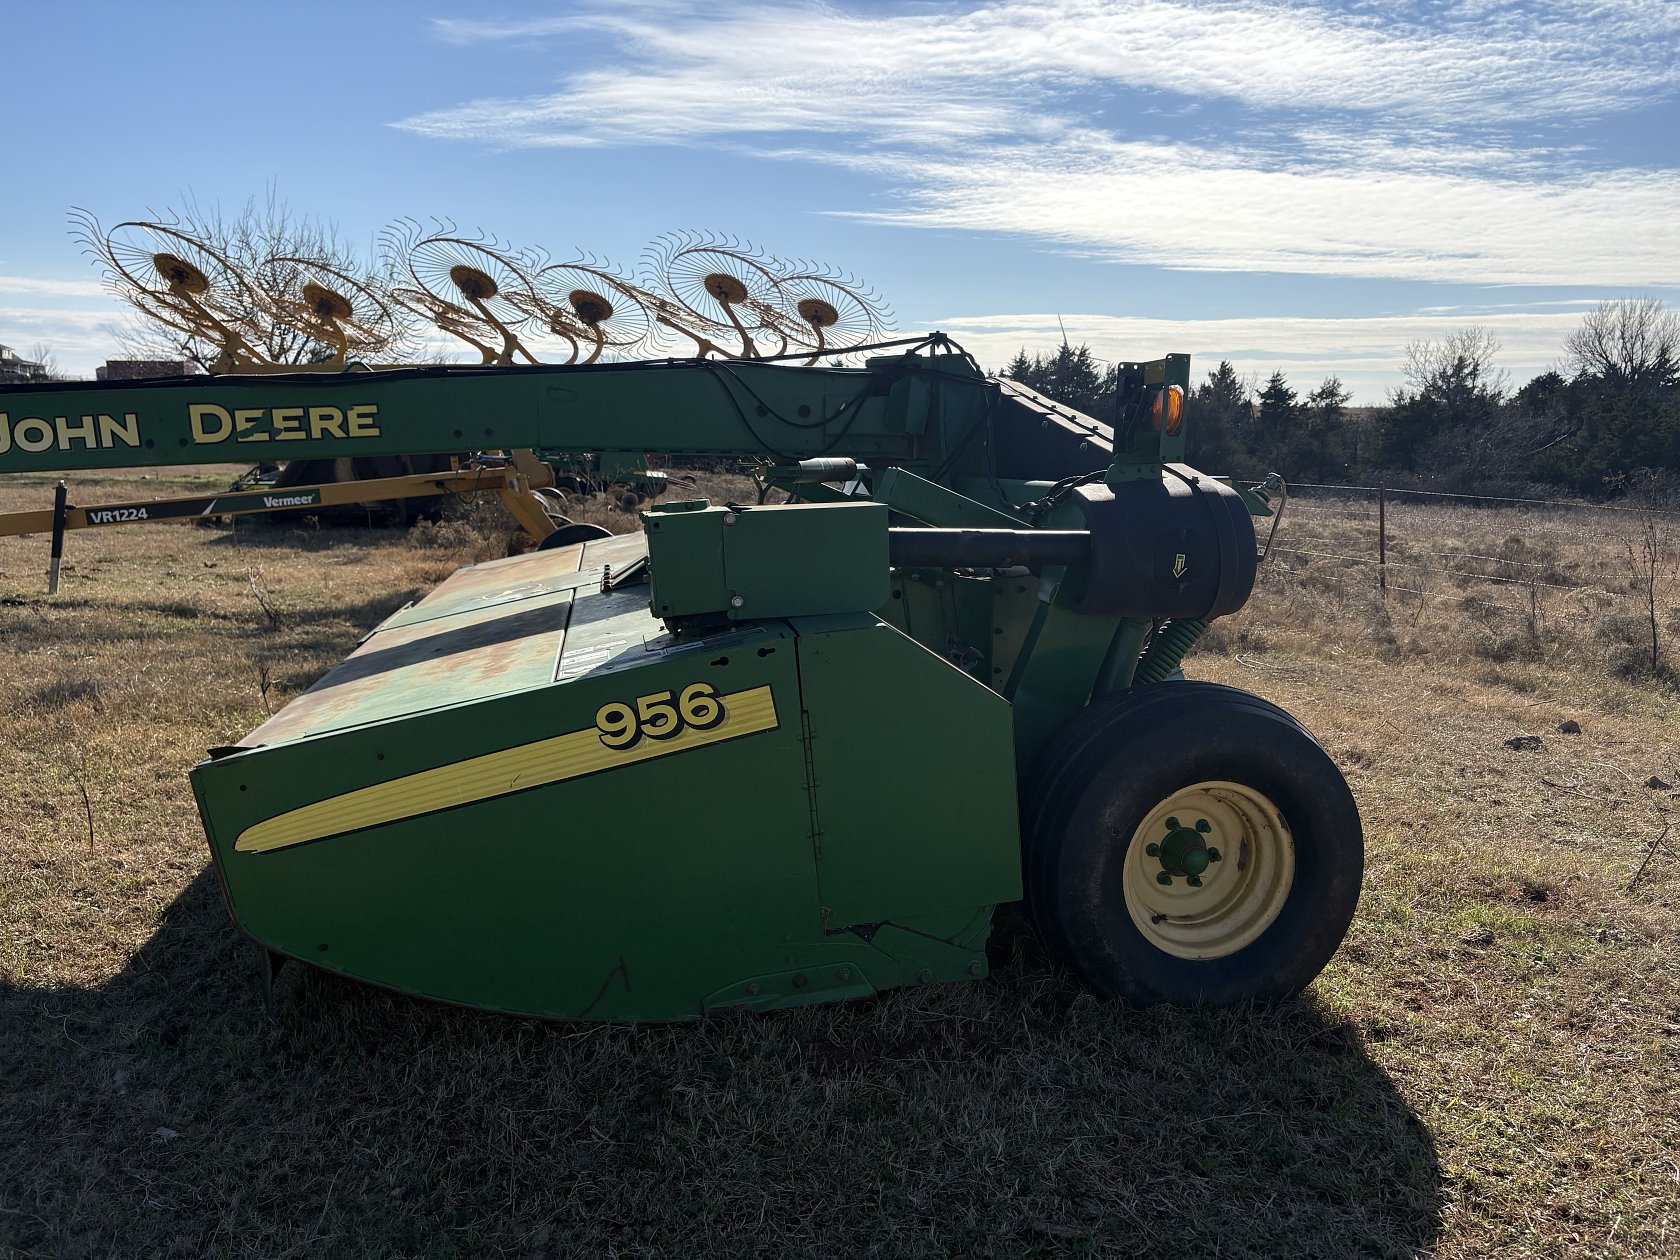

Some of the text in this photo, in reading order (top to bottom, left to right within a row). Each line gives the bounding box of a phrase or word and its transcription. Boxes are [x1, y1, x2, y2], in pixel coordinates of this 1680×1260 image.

[188, 404, 381, 444] DEERE
[263, 494, 315, 508] Vermeer
[89, 507, 149, 525] VR1224
[595, 682, 725, 750] 956
